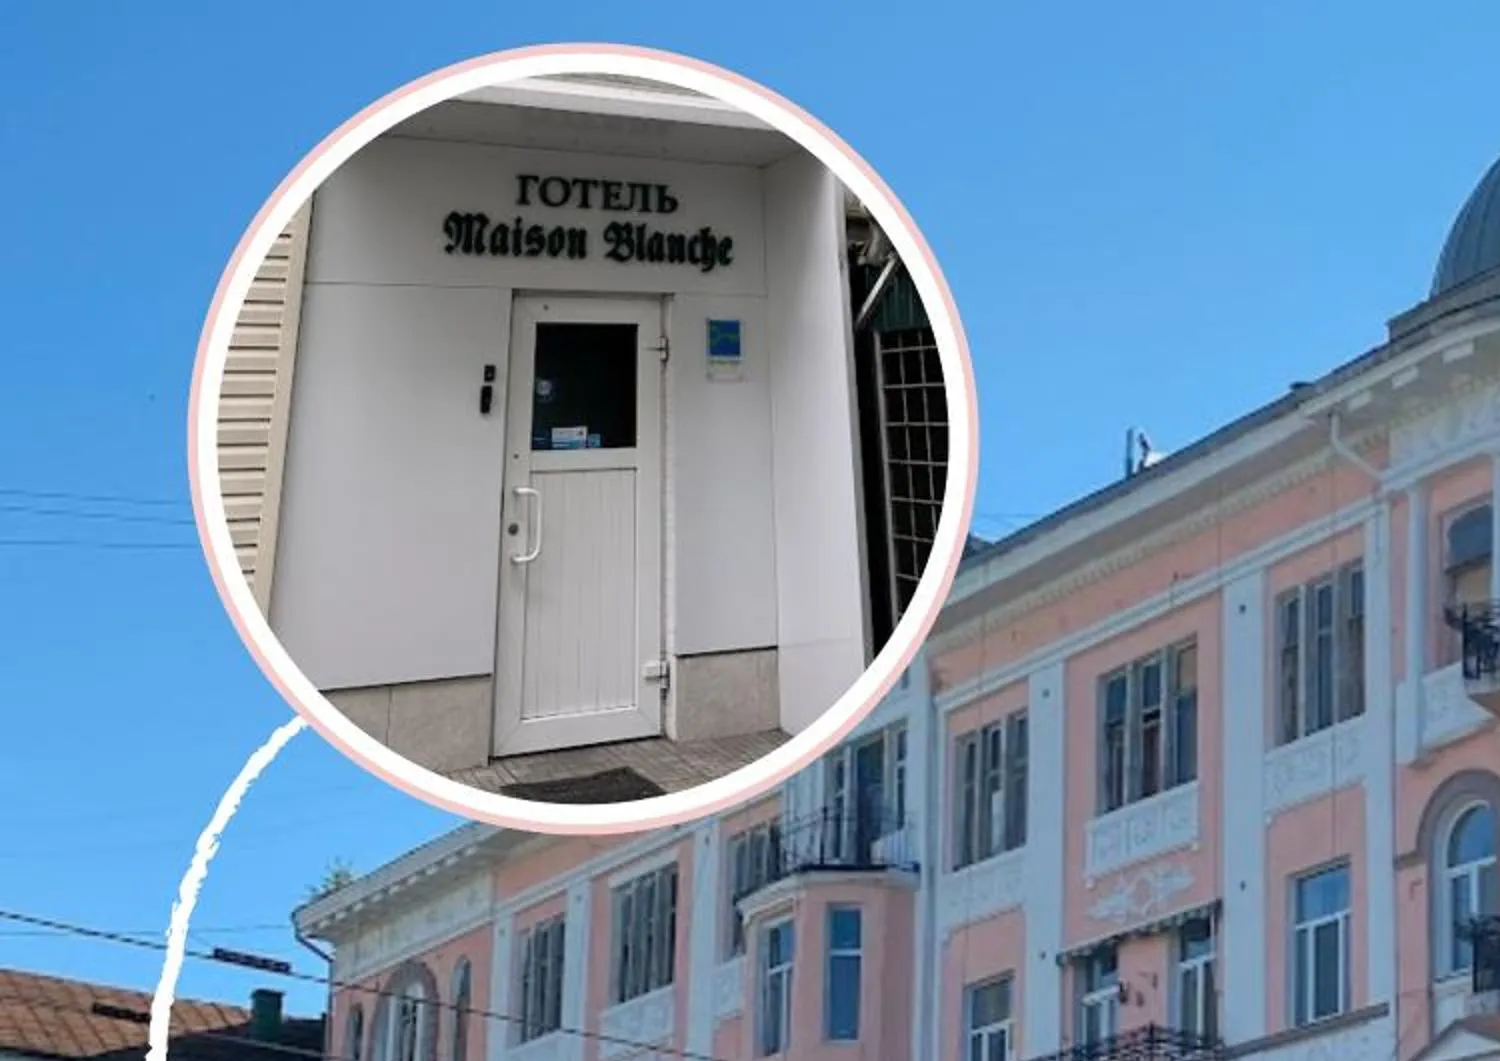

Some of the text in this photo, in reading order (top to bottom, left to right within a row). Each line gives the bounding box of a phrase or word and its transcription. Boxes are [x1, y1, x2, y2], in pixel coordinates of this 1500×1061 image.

[515, 174, 679, 213] ГОТЕЛЬ
[443, 211, 734, 272] Maison Blanche
